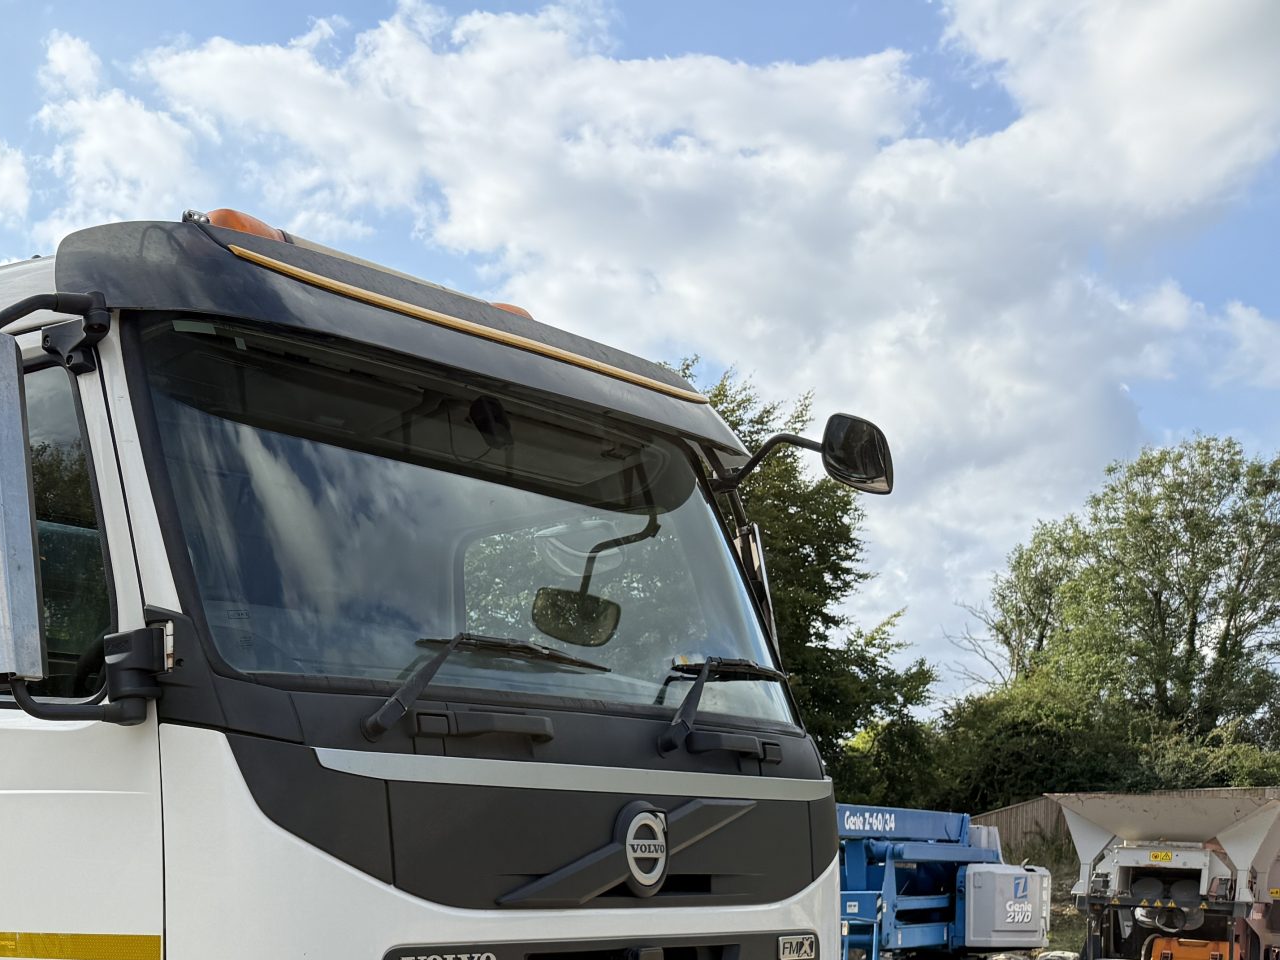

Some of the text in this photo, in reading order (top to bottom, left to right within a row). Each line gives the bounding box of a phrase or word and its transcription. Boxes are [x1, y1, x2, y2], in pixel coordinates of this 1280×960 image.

[844, 811, 863, 830] Genie
[629, 843, 665, 854] VOLVO
[1006, 900, 1032, 912] Genie
[1005, 911, 1032, 923] 2WD
[782, 936, 815, 958] FMX
